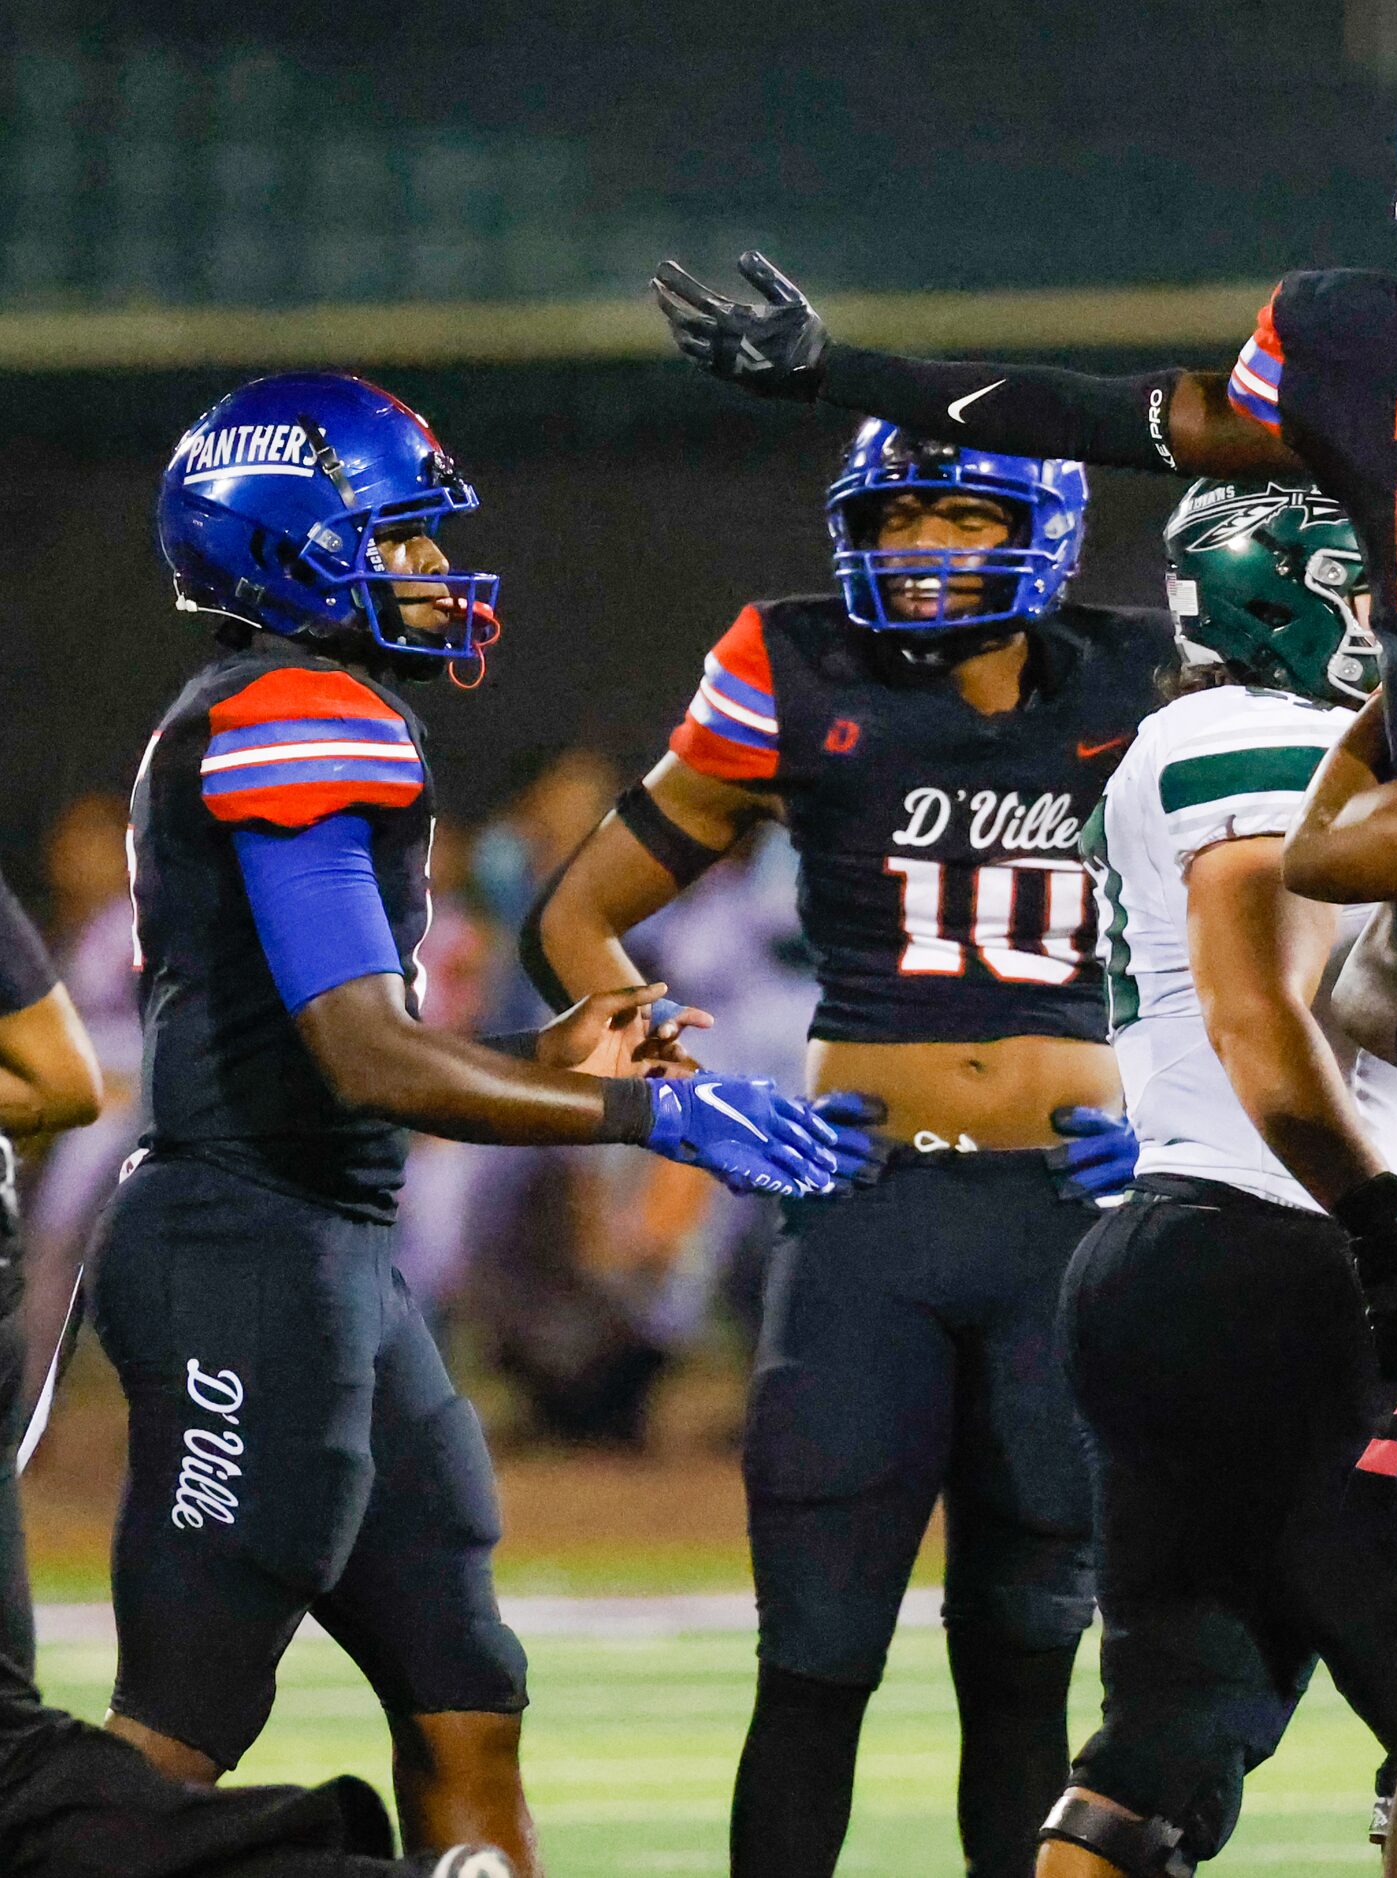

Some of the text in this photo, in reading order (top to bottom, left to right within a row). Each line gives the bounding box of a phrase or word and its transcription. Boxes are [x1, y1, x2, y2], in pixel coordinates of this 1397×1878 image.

[1148, 388, 1163, 440] PRO
[891, 786, 1081, 850] D'Ville
[882, 855, 1091, 985] 10
[171, 1358, 244, 1529] D'Ville
